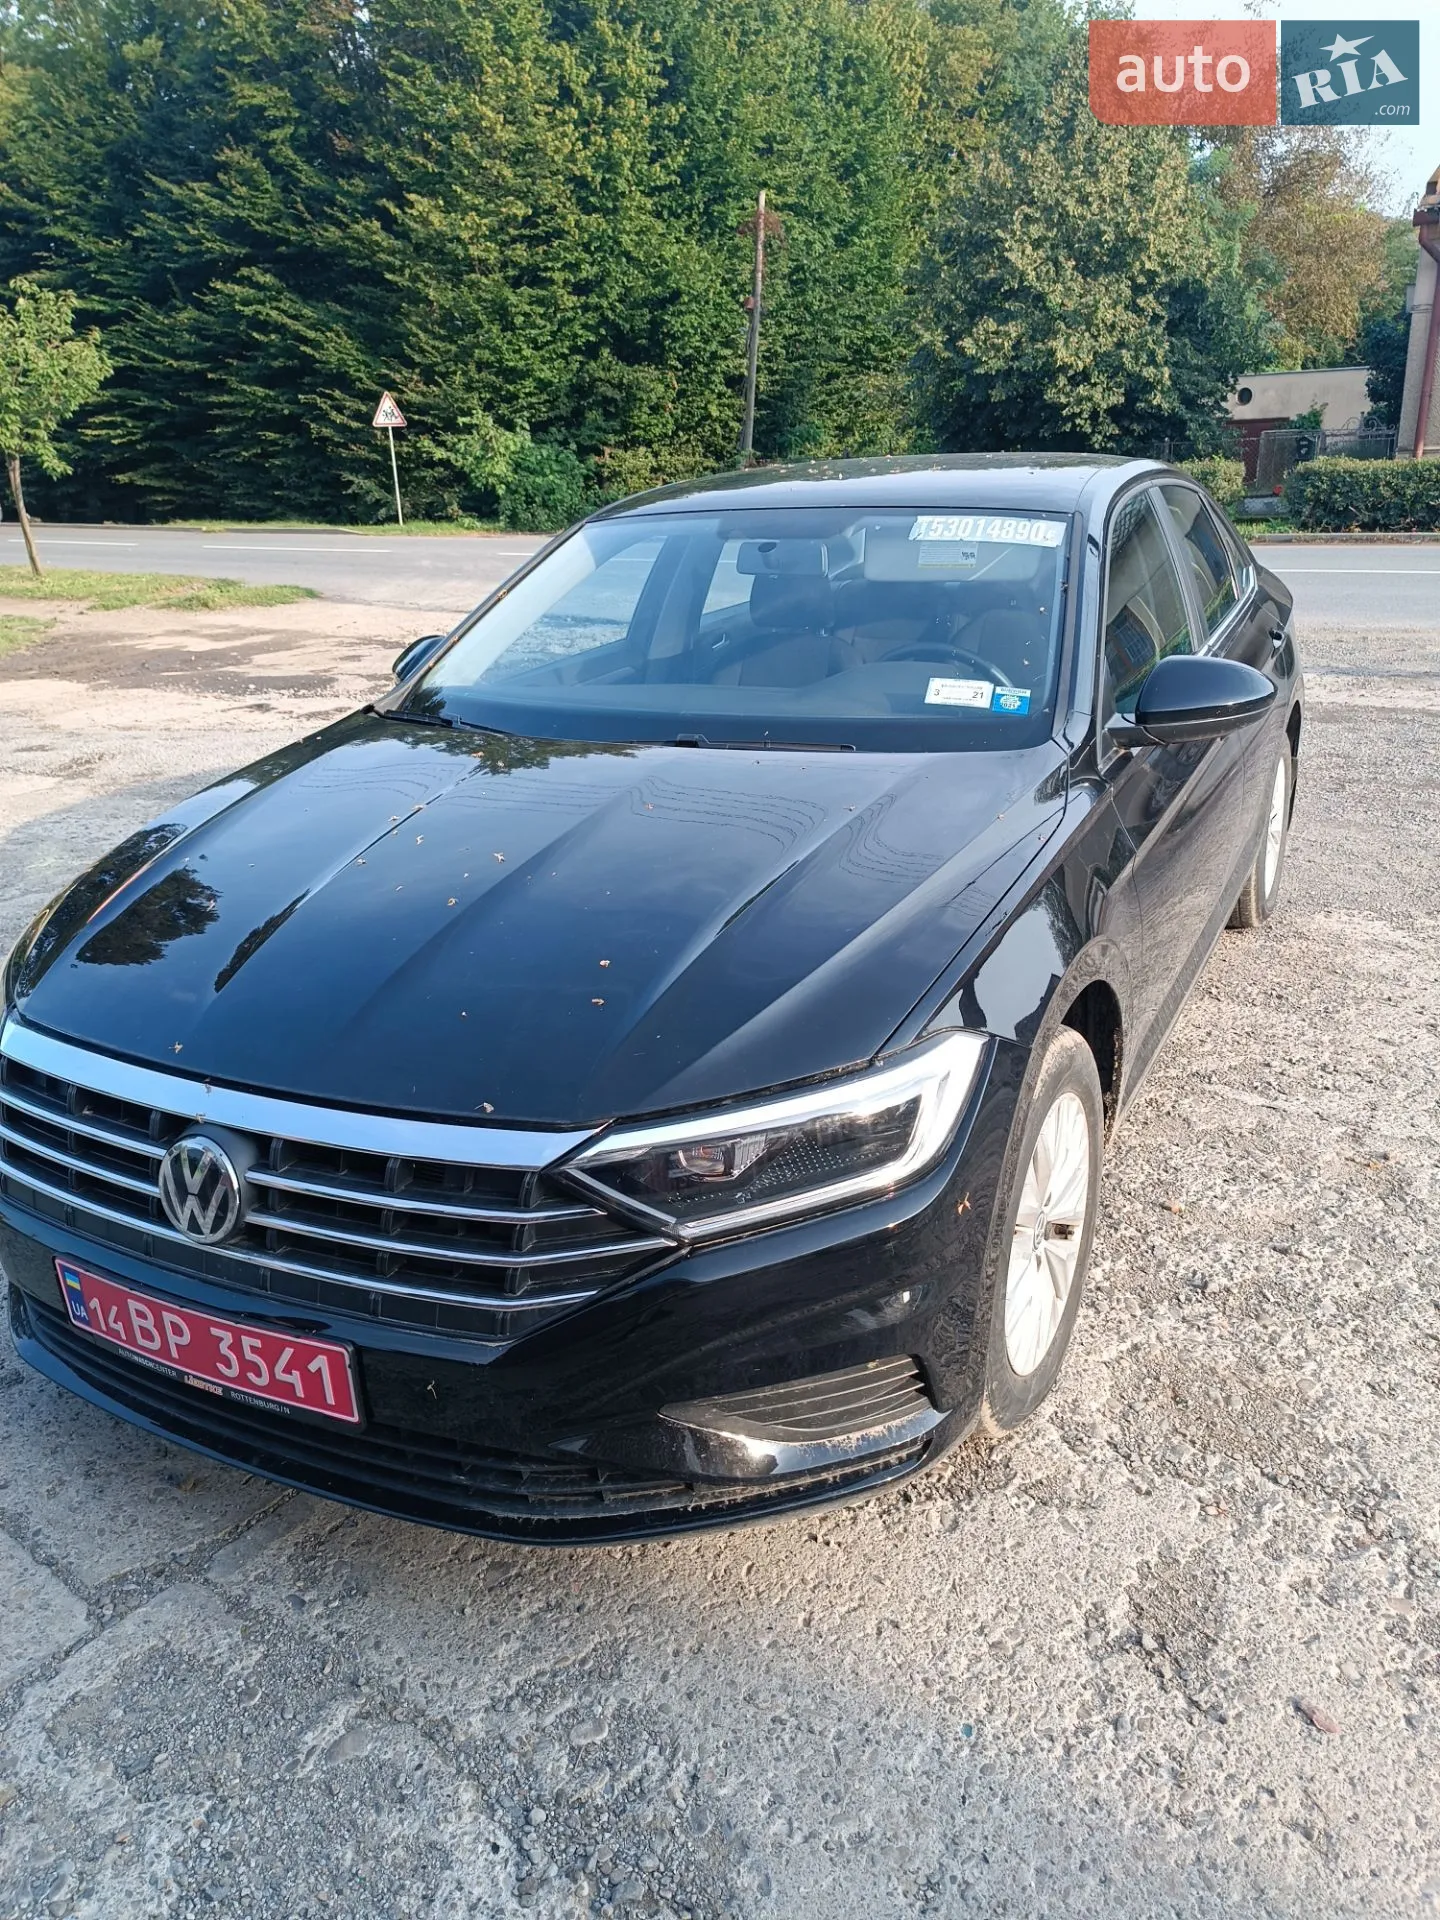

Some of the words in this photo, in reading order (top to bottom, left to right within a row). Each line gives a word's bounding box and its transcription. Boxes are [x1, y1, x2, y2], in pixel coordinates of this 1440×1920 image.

[933, 688, 940, 697] 3
[971, 691, 984, 699] 21
[71, 1300, 89, 1321] UA
[209, 1327, 336, 1406] 3541
